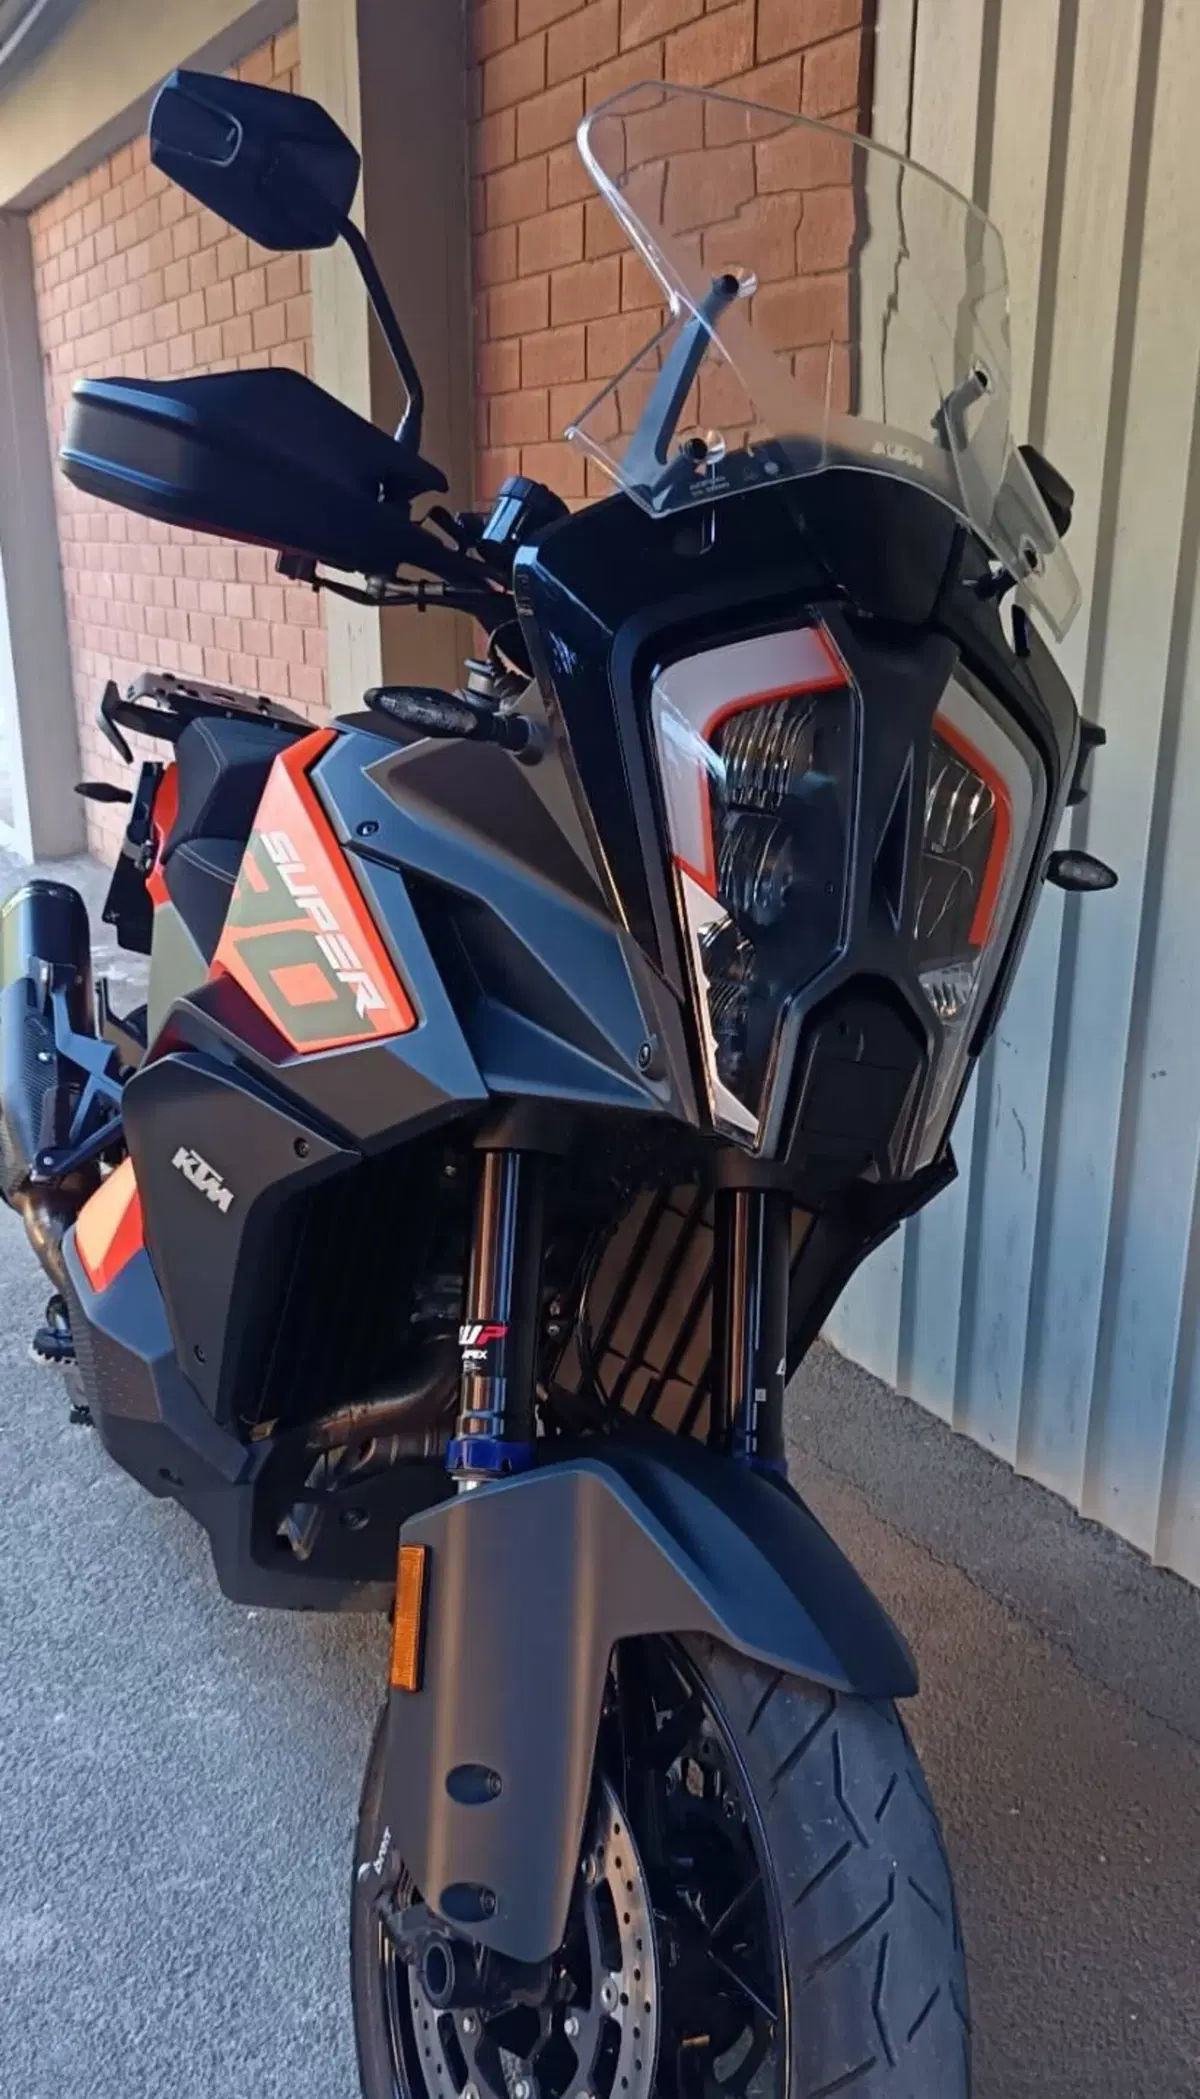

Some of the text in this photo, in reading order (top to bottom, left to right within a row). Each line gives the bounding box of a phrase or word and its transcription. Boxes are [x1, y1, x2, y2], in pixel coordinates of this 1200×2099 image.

[260, 831, 387, 1020] SUPER
[171, 1146, 235, 1213] KTM
[458, 1325, 508, 1345] WP
